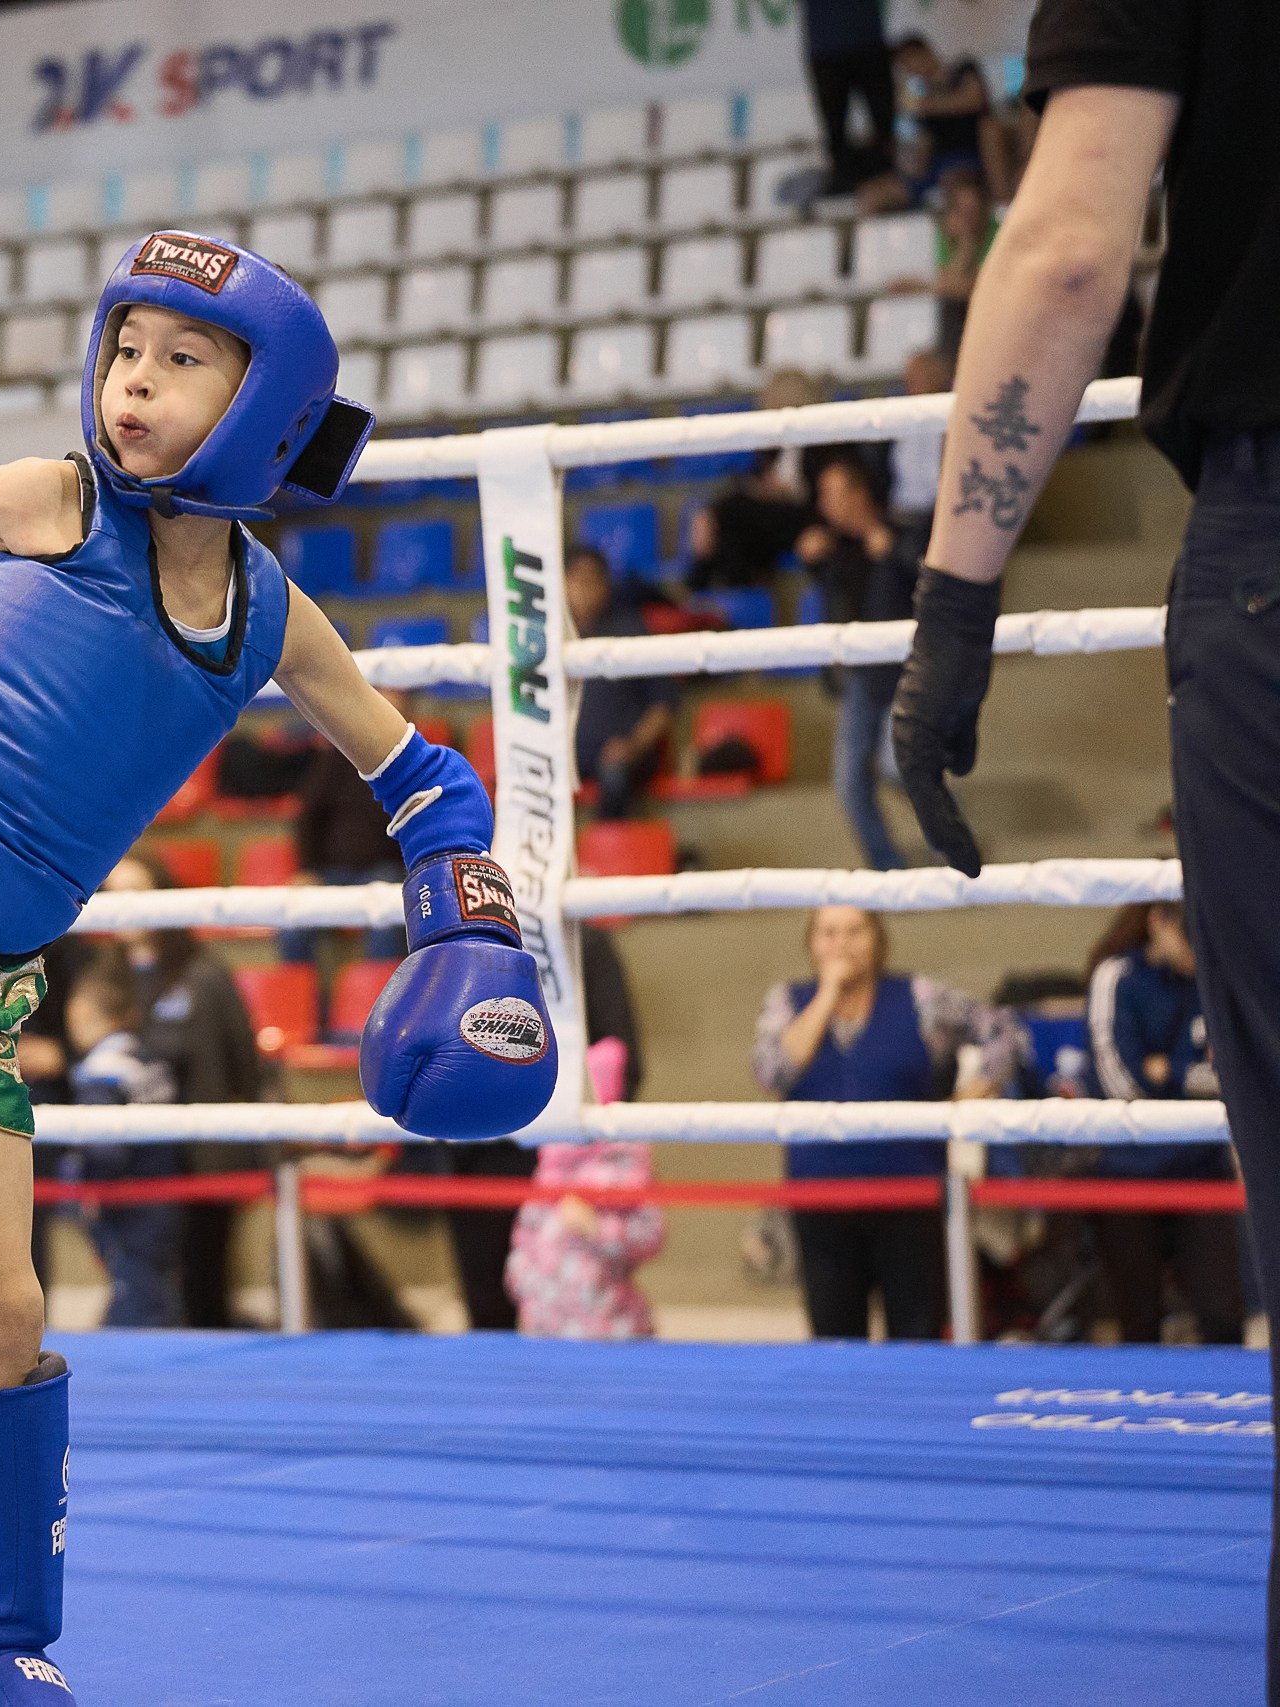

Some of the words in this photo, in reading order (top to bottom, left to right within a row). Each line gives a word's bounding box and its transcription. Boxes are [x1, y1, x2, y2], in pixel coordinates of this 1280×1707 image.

[157, 20, 398, 118] SPORT
[145, 238, 230, 280] TWINS
[418, 884, 432, 900] 10
[467, 1018, 542, 1049] TWINS
